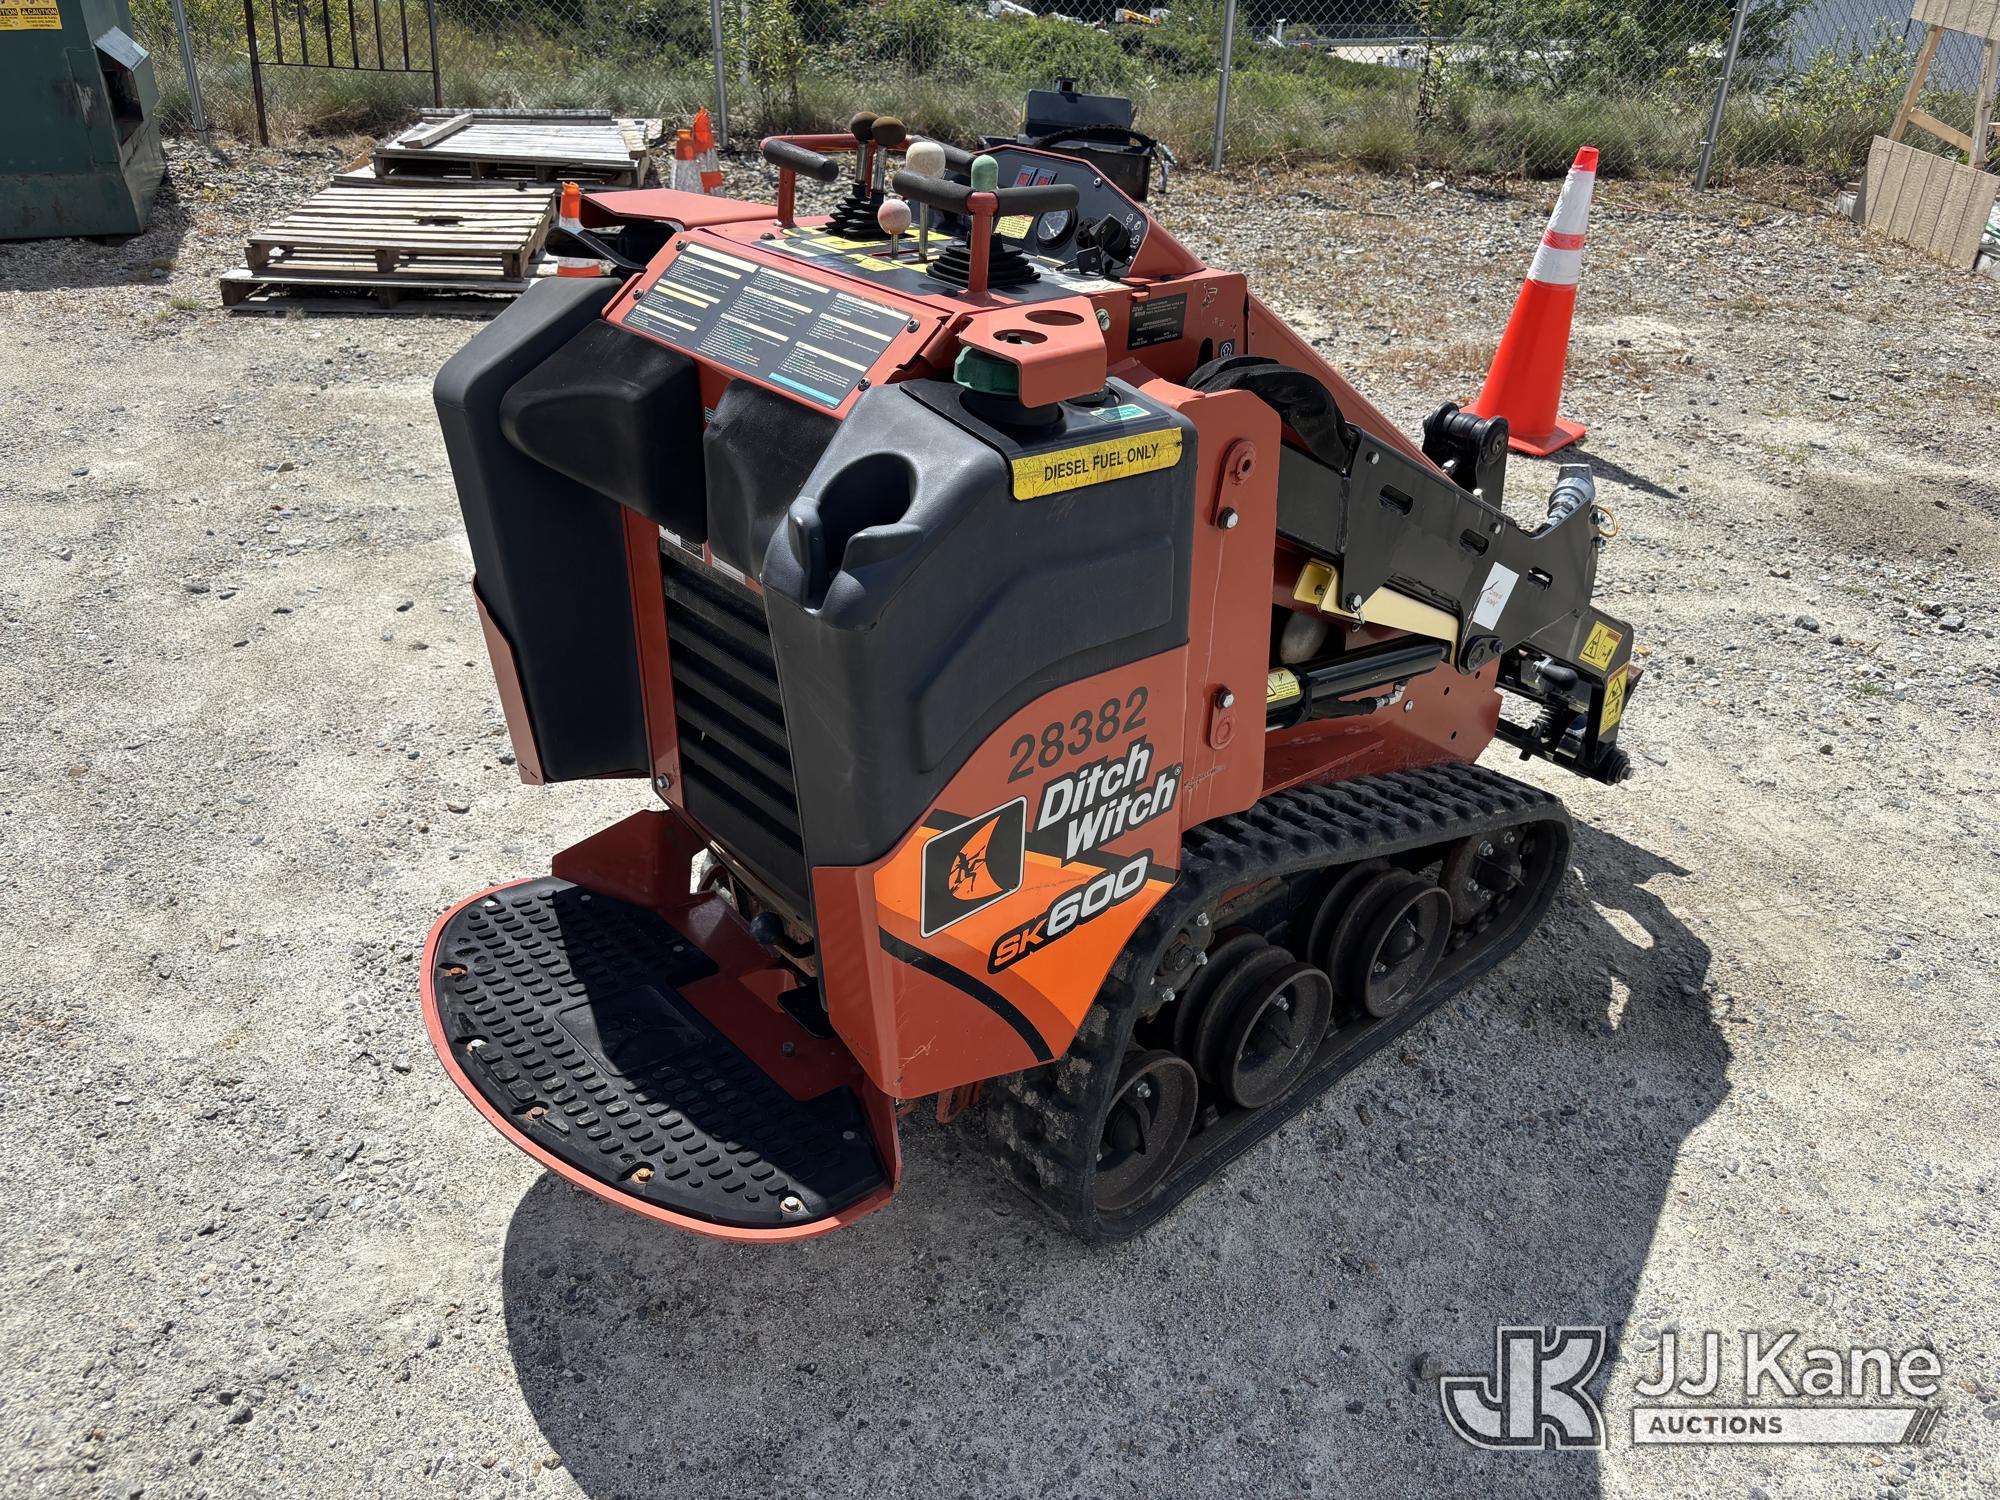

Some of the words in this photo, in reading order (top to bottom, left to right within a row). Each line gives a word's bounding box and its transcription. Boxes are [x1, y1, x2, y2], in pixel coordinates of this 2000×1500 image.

[0, 8, 17, 16] TION
[28, 8, 58, 16] CAUTION
[1044, 458, 1089, 481] DIESEL
[1093, 451, 1124, 471] FUEL
[1127, 443, 1160, 463] ONLY
[1007, 686, 1149, 783] 28382
[1036, 743, 1151, 831] Ditch
